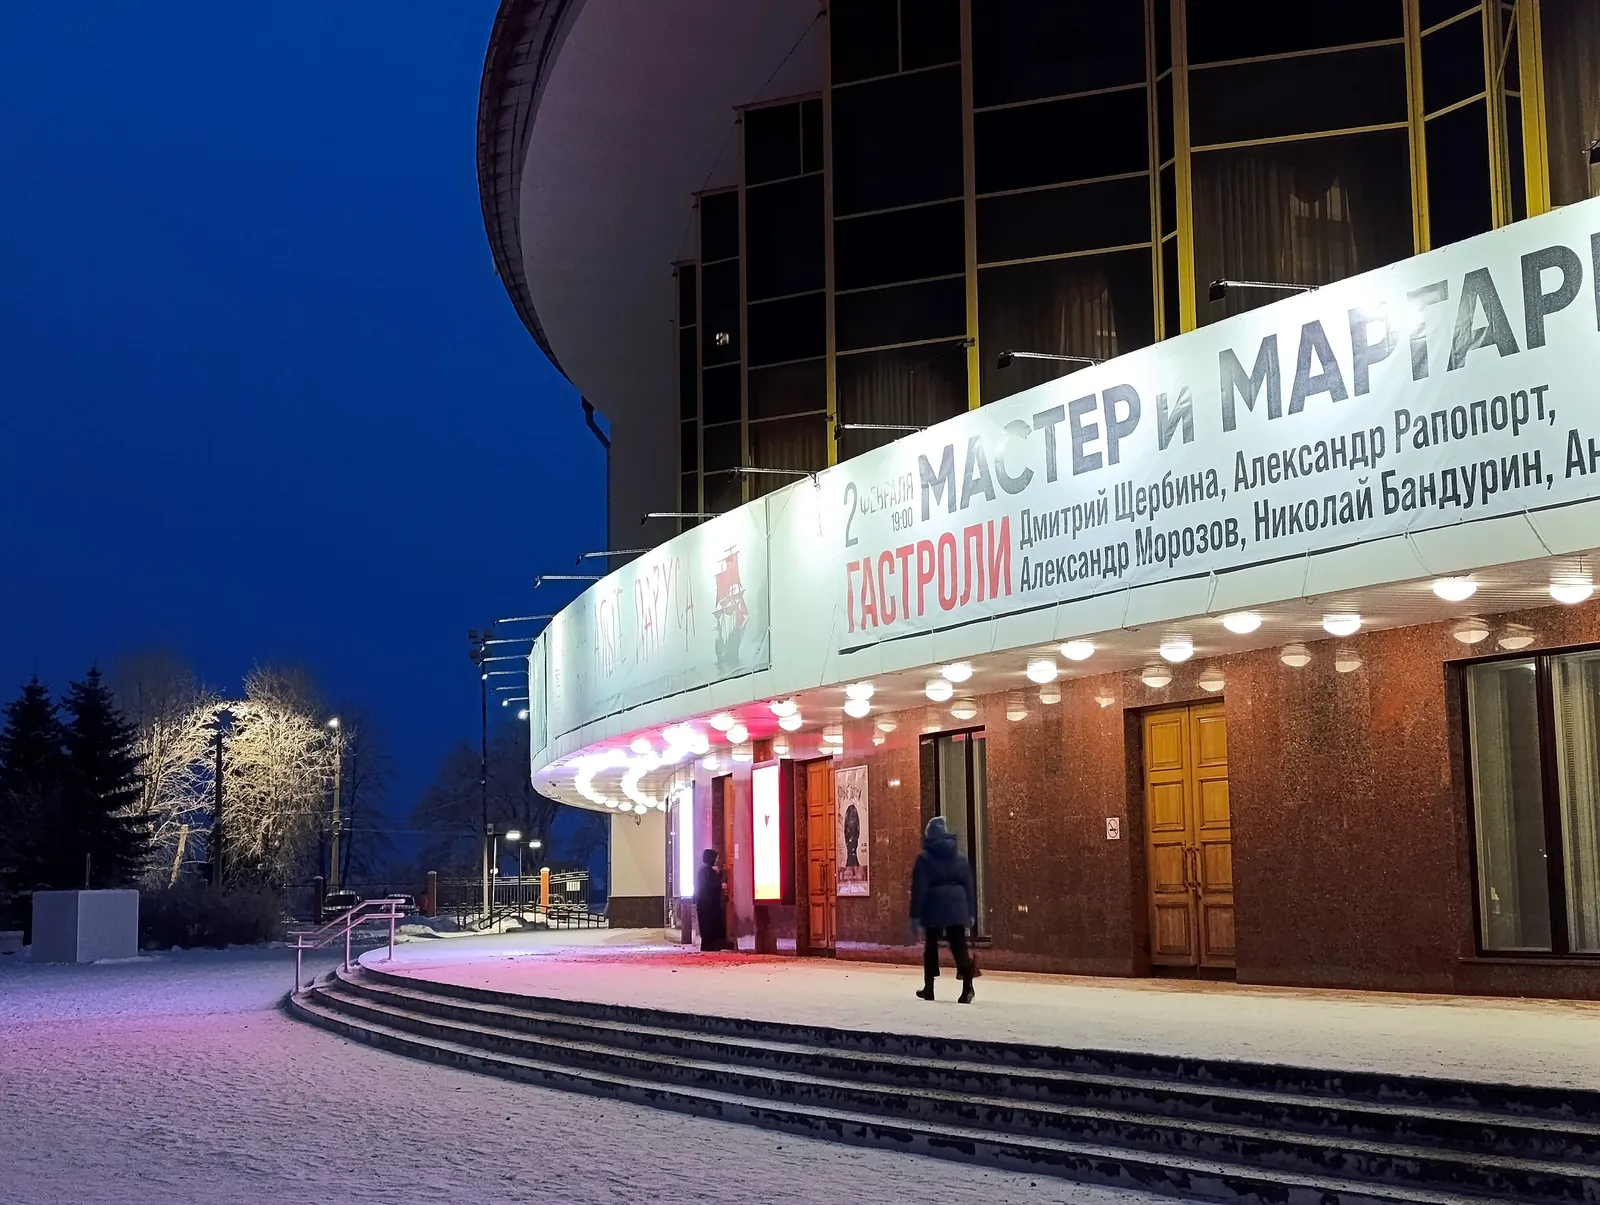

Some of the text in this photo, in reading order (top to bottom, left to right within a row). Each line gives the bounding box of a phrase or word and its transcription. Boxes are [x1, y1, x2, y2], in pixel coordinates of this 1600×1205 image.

[918, 383, 1141, 521] МАСТЕР
[1218, 231, 1600, 433] МАРГАР
[844, 481, 859, 548] 2
[891, 507, 913, 532] 19:00
[1019, 384, 1556, 551] Дмитрий Щербина, Александр Рапопорт,
[1019, 538, 1130, 593] Александр
[1134, 517, 1247, 568] Морозов,
[1253, 479, 1374, 542] Николай
[1380, 449, 1554, 516] Бандурин,
[846, 515, 1012, 633] ГАСТРОЛИ
